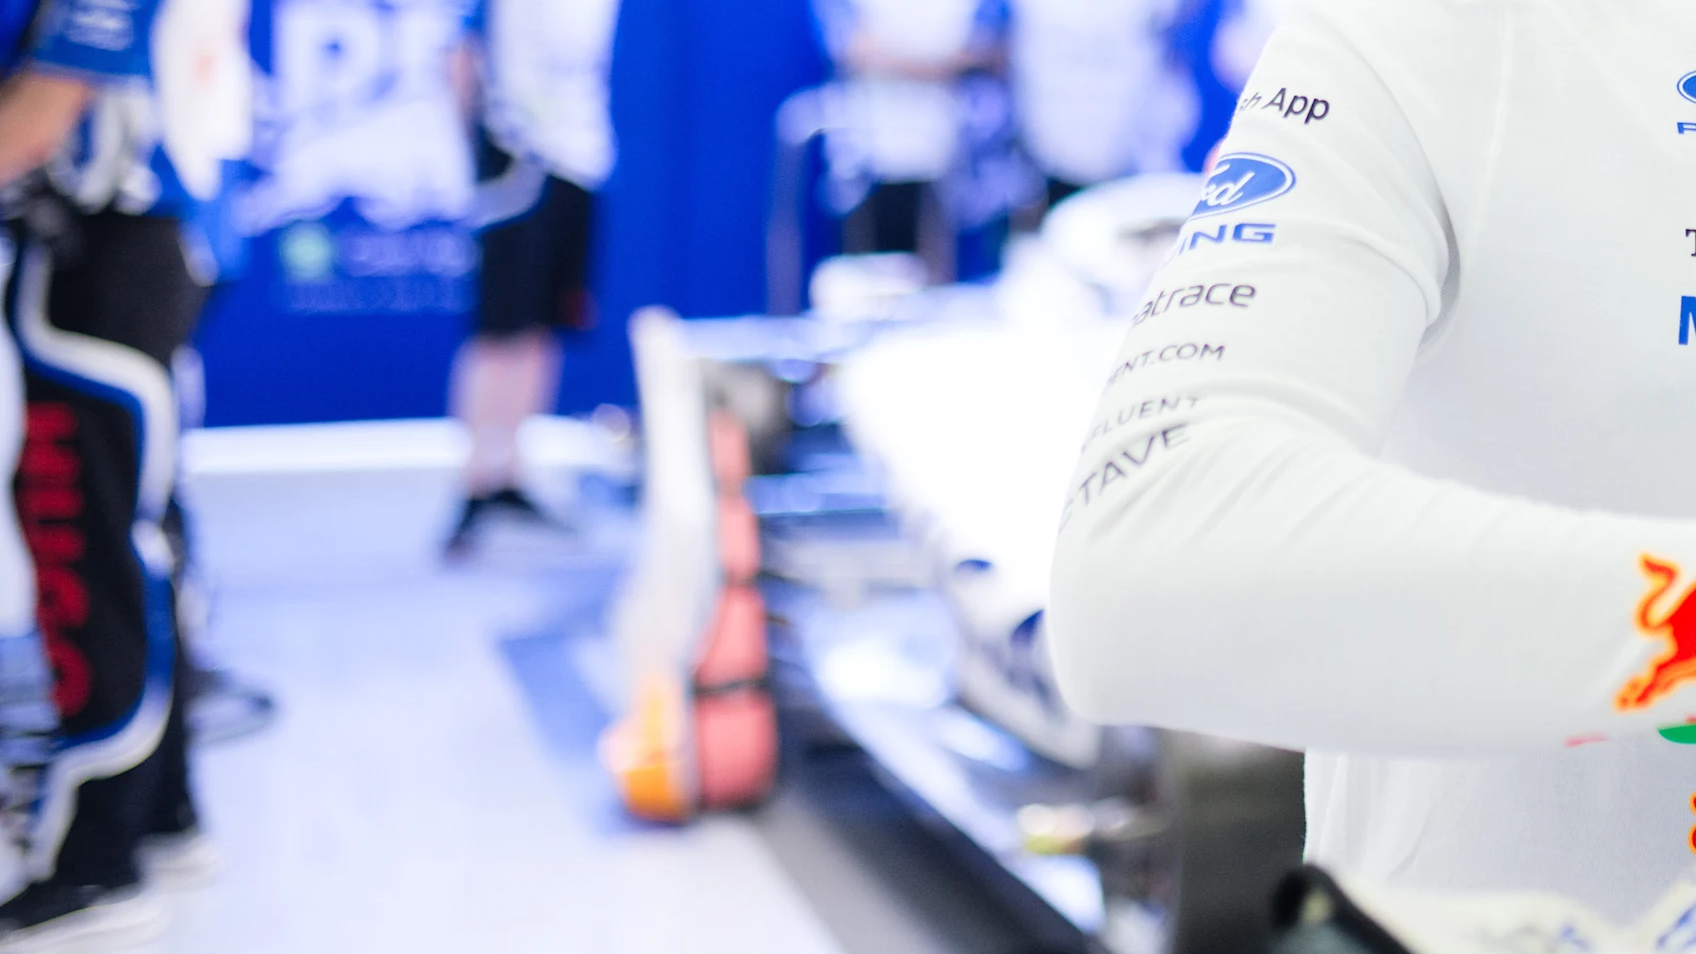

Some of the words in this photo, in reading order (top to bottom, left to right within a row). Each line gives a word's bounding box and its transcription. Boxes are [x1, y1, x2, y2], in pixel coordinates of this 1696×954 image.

[1261, 87, 1331, 125] App
[1166, 223, 1277, 264] ING
[1131, 282, 1257, 327] atrace
[1107, 342, 1226, 386] ENT.COM
[1082, 396, 1202, 454] FLUENT
